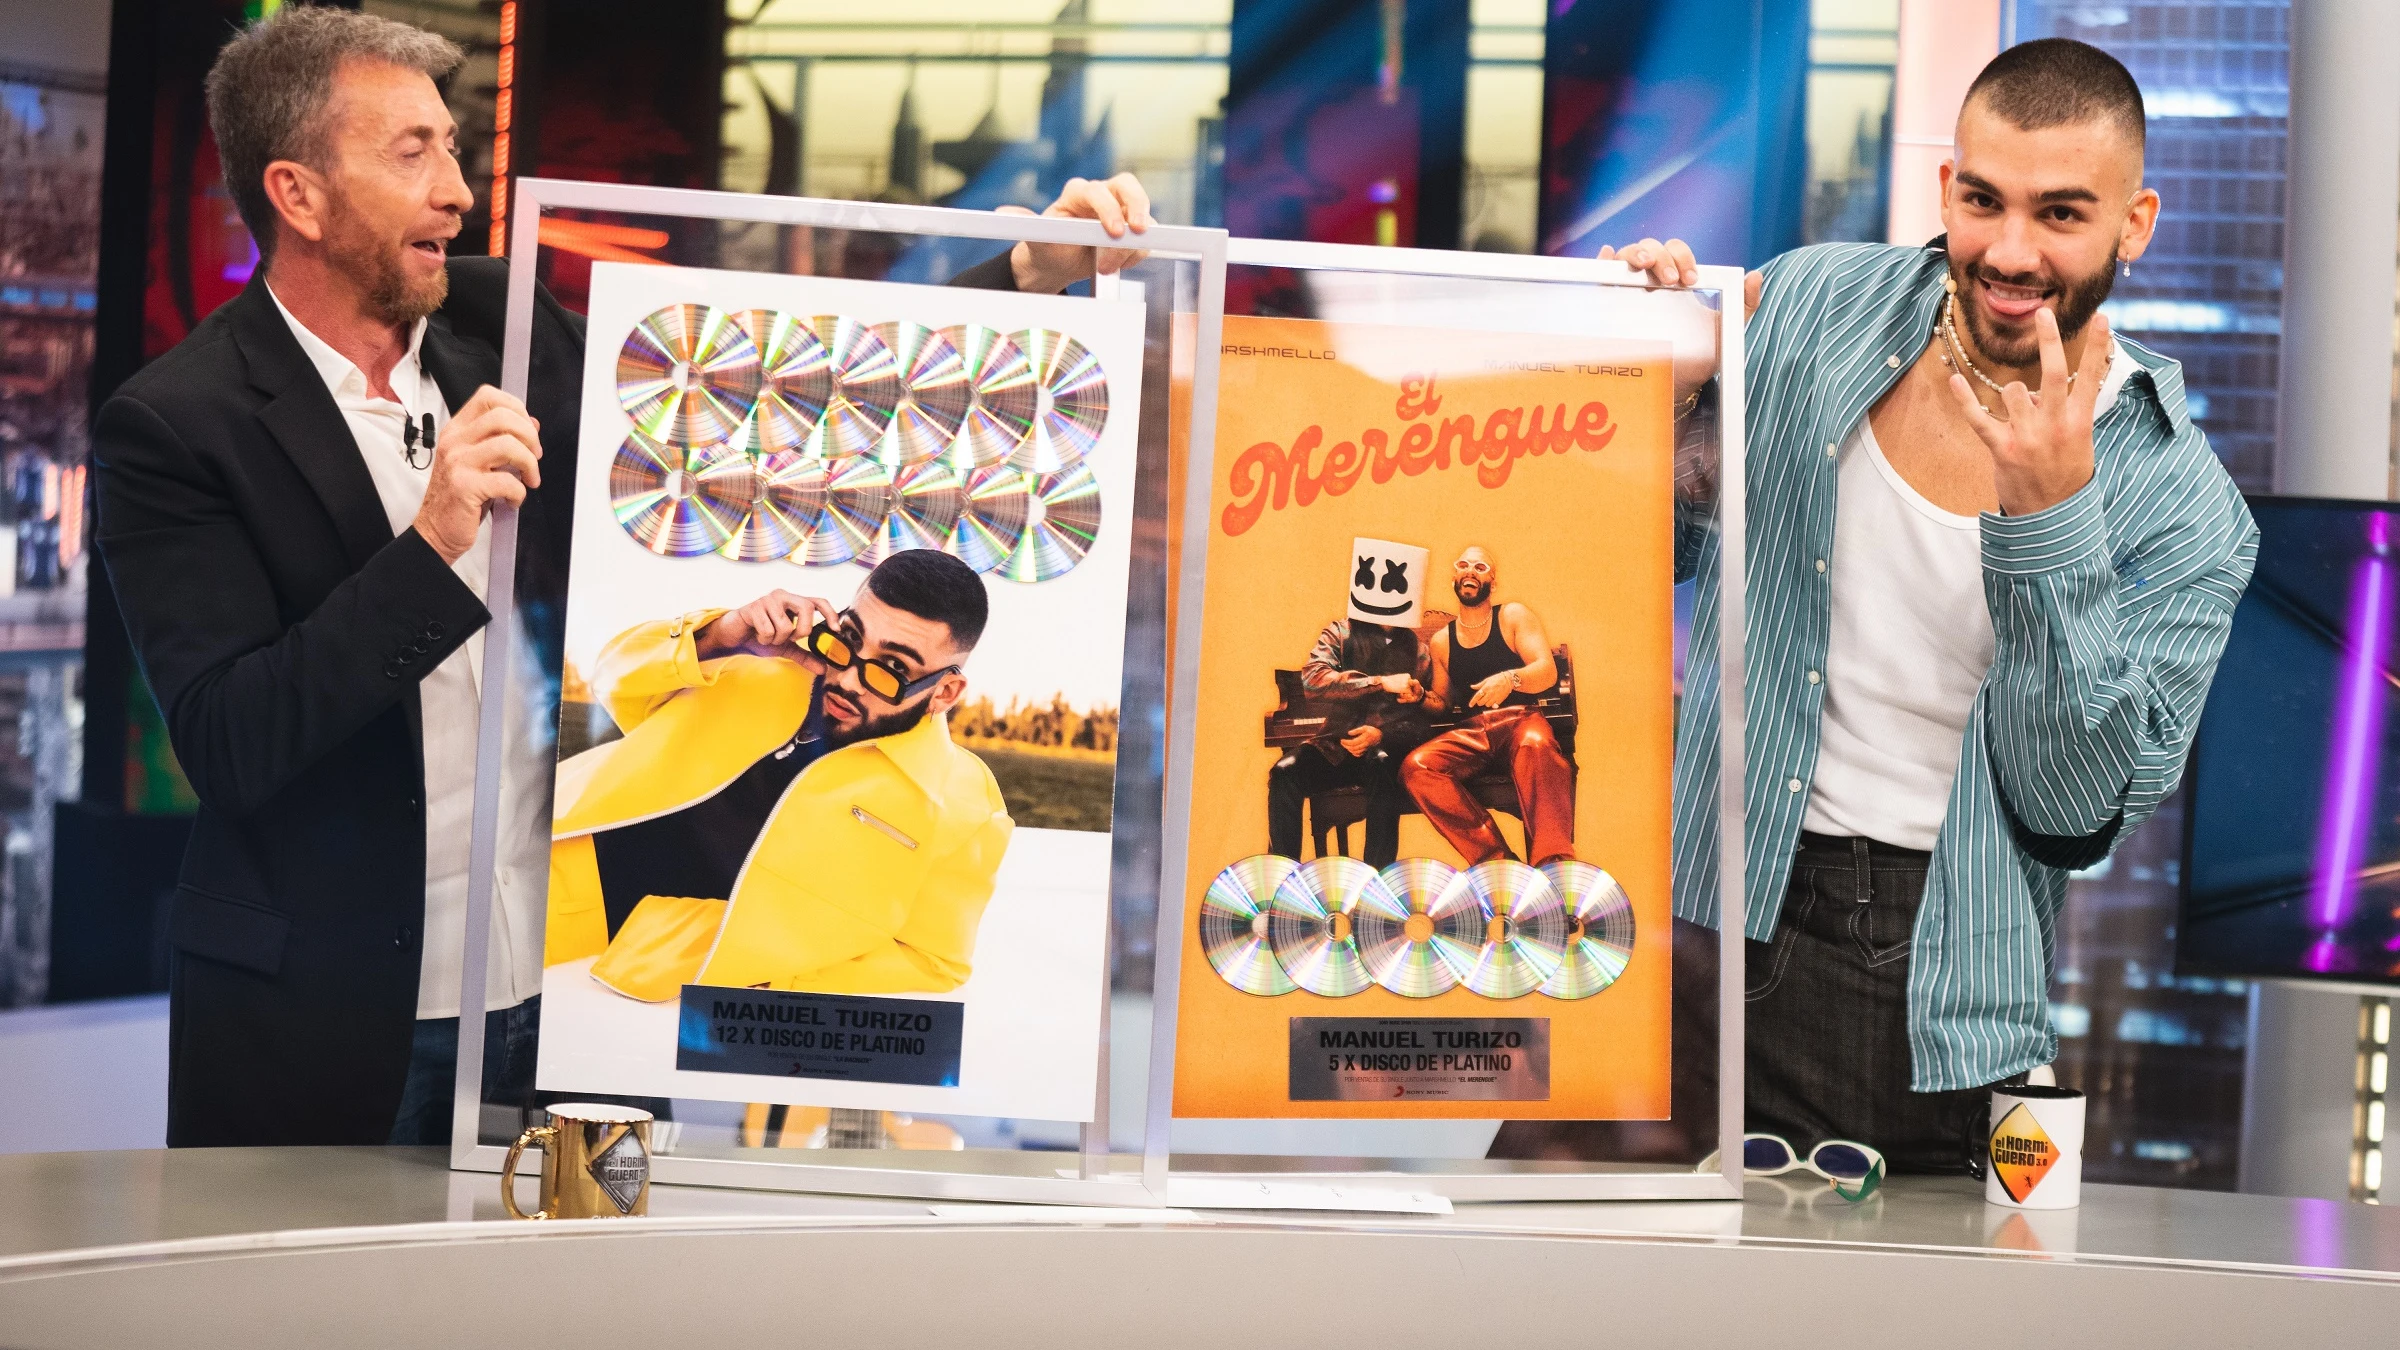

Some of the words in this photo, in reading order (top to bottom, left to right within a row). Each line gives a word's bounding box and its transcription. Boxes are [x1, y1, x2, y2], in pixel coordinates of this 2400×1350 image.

[1483, 359, 1566, 374] MANUEL
[1575, 364, 1643, 377] TURIZO
[1396, 369, 1443, 421] El
[1221, 401, 1618, 537] Merengue
[712, 1001, 827, 1026] MANUEL
[834, 1009, 932, 1033] TURIZO
[716, 1025, 739, 1043] 12
[743, 1026, 756, 1044] X
[761, 1028, 816, 1049] DISCO
[821, 1032, 845, 1051] DE
[850, 1034, 925, 1056] PLATINO
[1320, 1031, 1425, 1048] MANUEL
[1432, 1031, 1521, 1048] TURIZO
[1329, 1054, 1340, 1071] 5
[1344, 1054, 1356, 1071] X
[1361, 1054, 1411, 1071] DISCO
[1416, 1054, 1438, 1071] DE
[1443, 1054, 1512, 1071] PLATINO
[1995, 1137, 2005, 1149] el
[2036, 1158, 2048, 1167] 3.0
